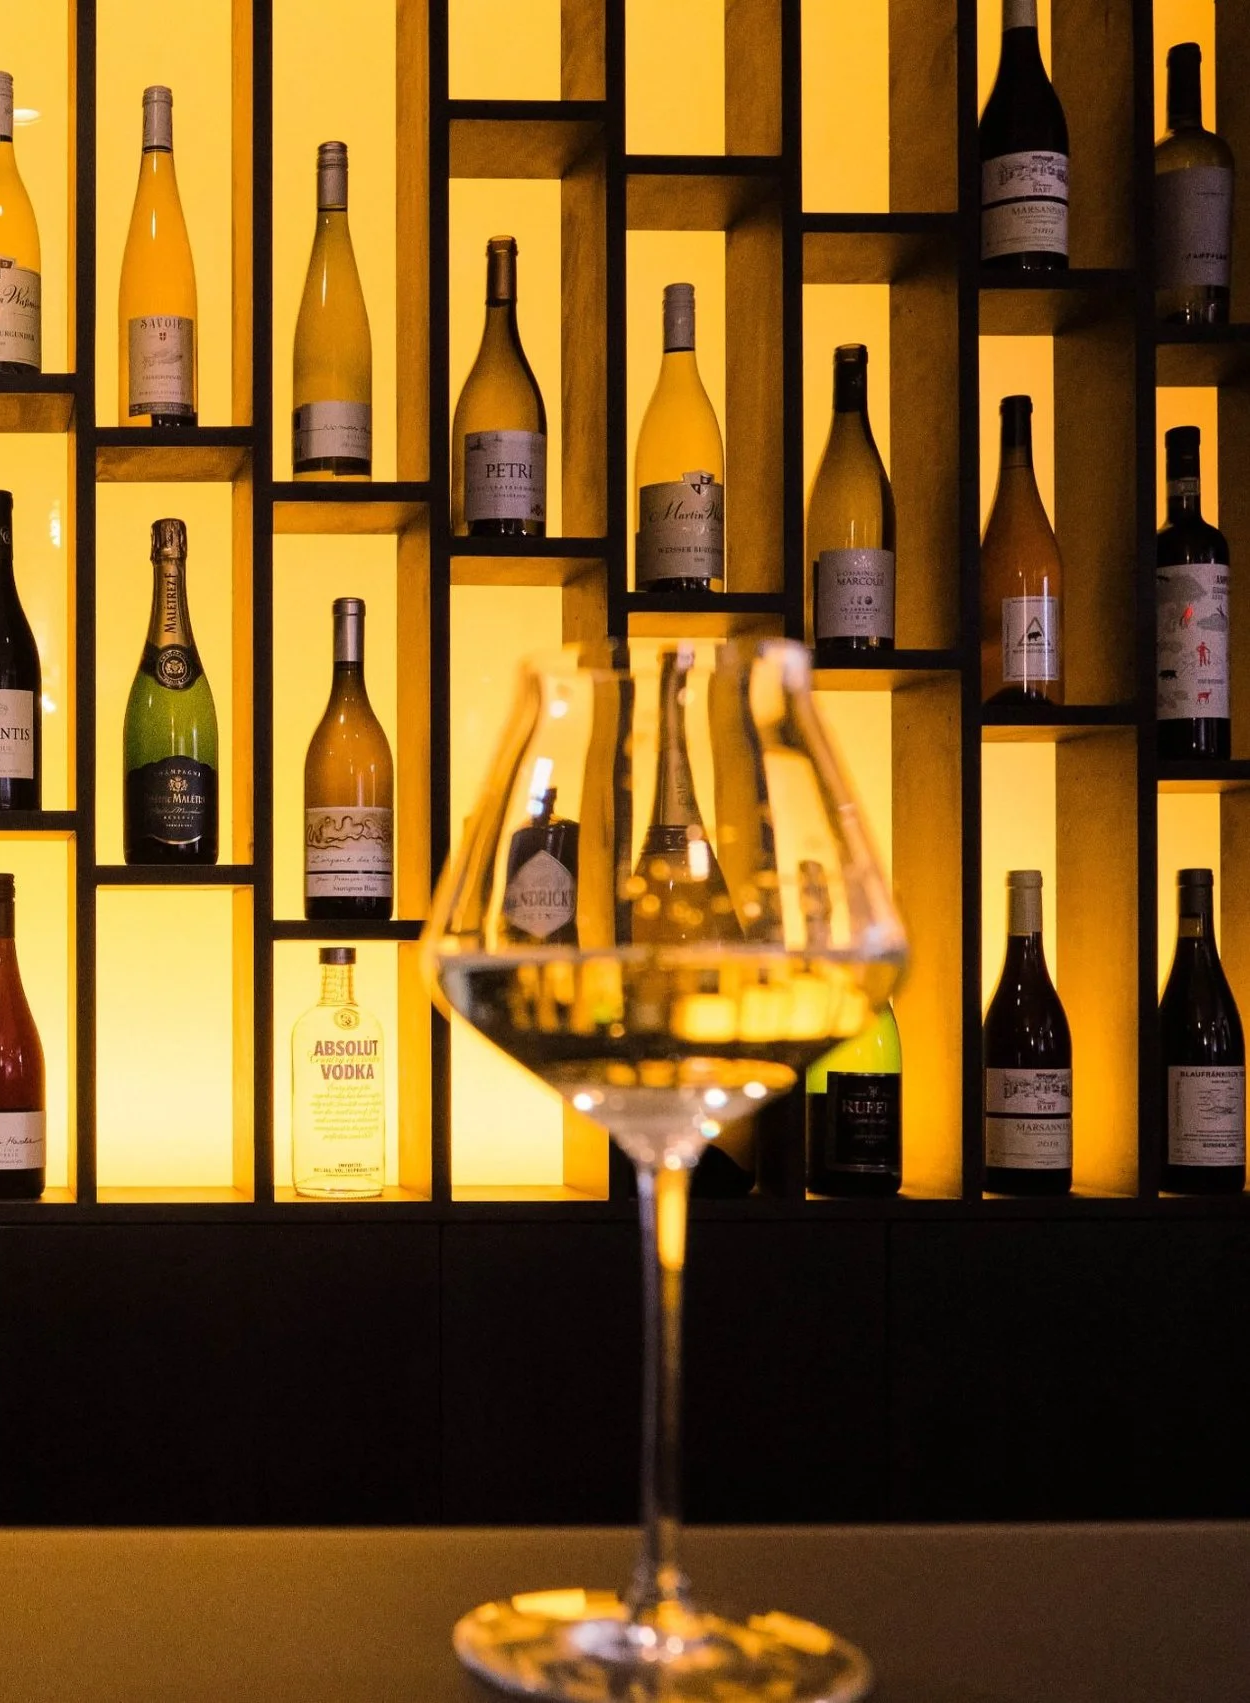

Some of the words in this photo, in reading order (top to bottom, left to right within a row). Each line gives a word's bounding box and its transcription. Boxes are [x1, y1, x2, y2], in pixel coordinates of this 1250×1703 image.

[140, 318, 182, 330] SAVOIE
[485, 462, 533, 479] PETRI
[313, 1039, 379, 1057] ABSOLUT
[320, 1064, 375, 1080] VODKA
[842, 1100, 888, 1114] RUFF
